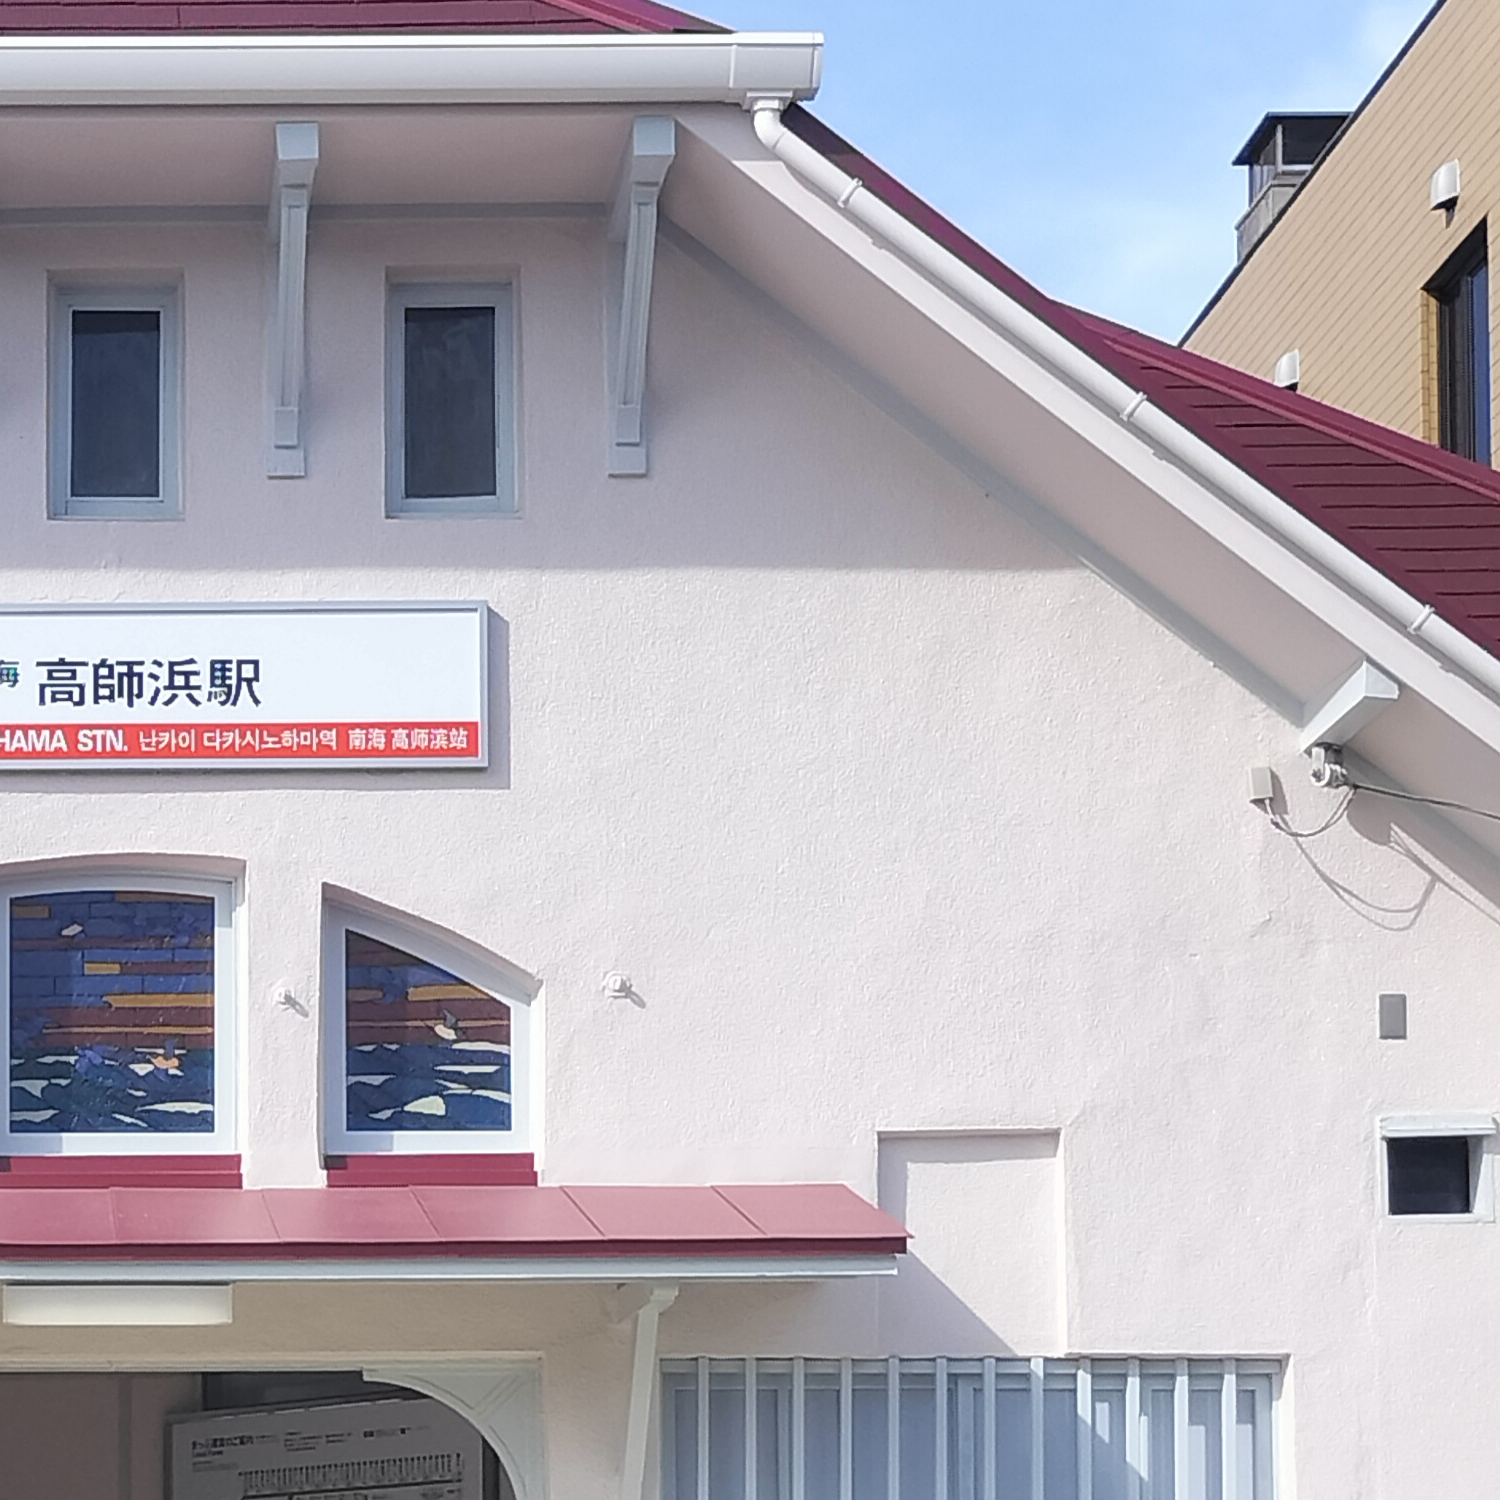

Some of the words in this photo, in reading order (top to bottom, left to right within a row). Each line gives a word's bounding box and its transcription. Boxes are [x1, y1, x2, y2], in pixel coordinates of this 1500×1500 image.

[35, 657, 262, 708] 高師浜駅
[77, 729, 128, 753] STN.
[138, 728, 195, 753] 난카이
[203, 727, 337, 753] 다카시노하마역
[348, 727, 386, 751] 南海
